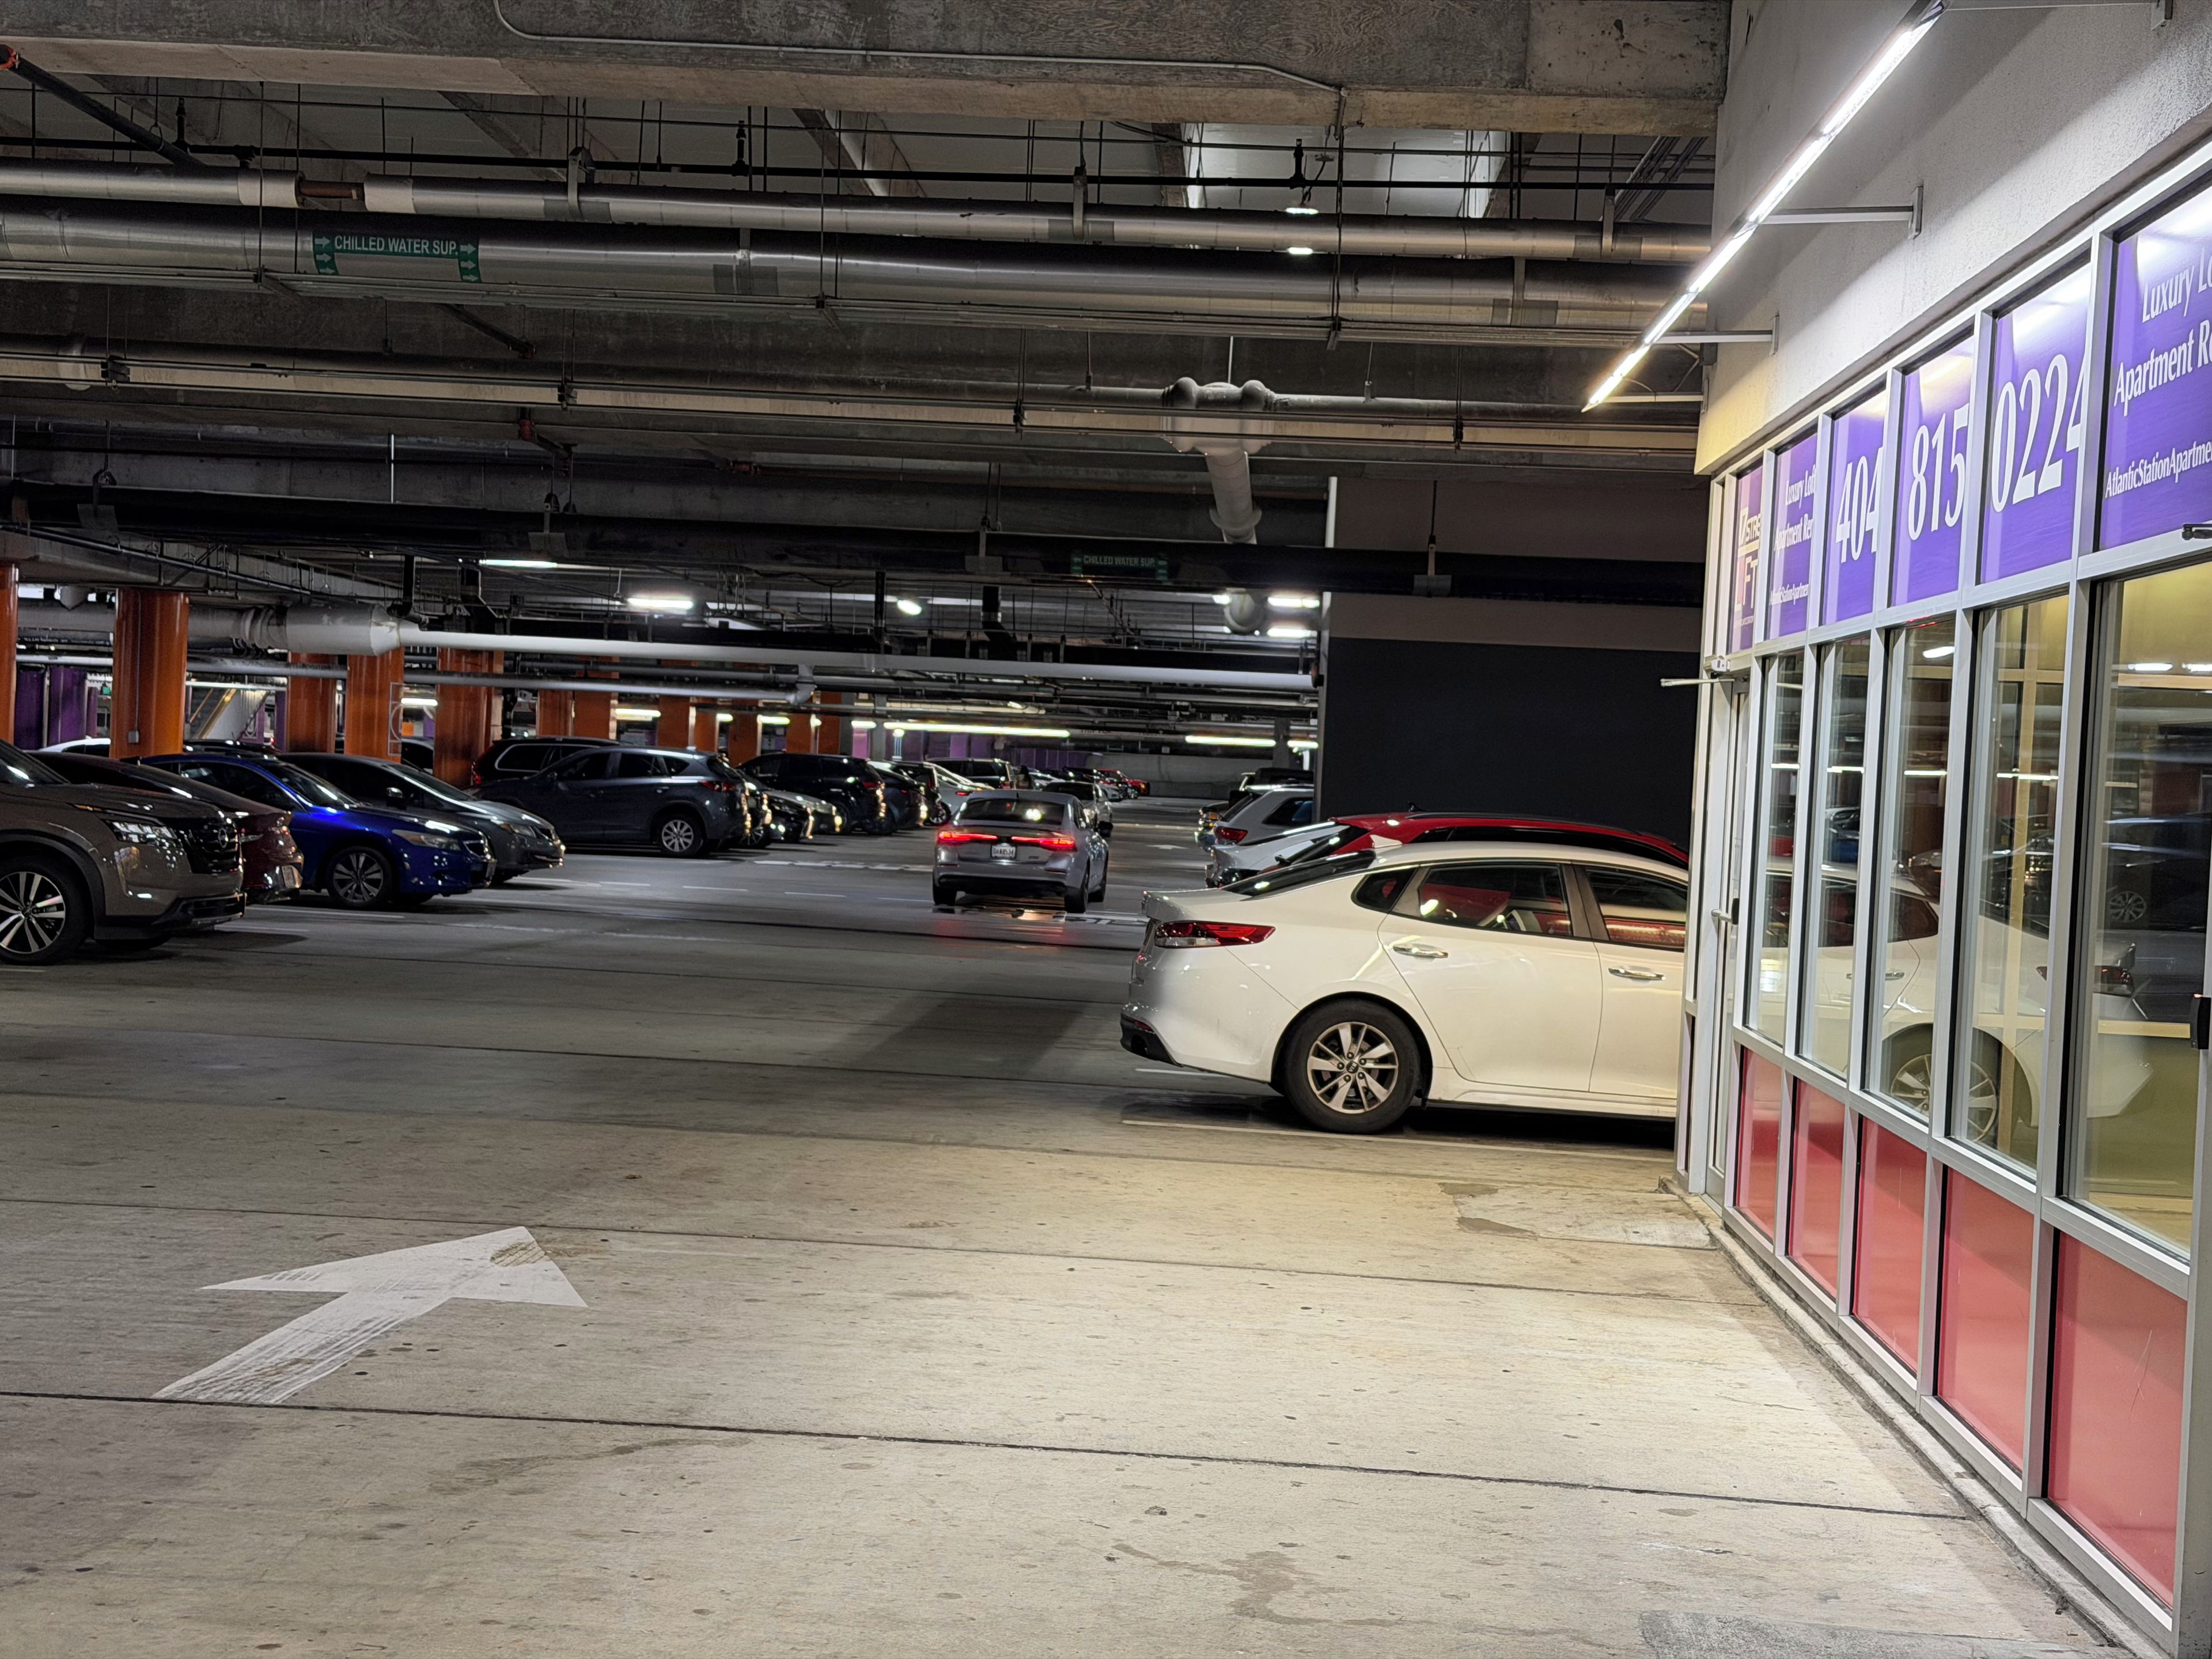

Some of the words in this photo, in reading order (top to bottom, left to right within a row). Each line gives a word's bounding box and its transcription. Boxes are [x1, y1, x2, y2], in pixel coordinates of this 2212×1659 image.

[335, 235, 385, 251] CHILLED
[388, 237, 430, 254] WATER
[432, 240, 459, 256] SUP.
[2142, 265, 2195, 323] Luxury
[2113, 328, 2195, 417] Apartment
[1835, 446, 1883, 564] 404
[1908, 402, 1969, 540] 815
[1991, 349, 2086, 513] 0224
[2105, 440, 2212, 499] AtlanticStationApartme
[1084, 555, 1113, 565] CHILLED
[1115, 556, 1139, 566] WATER
